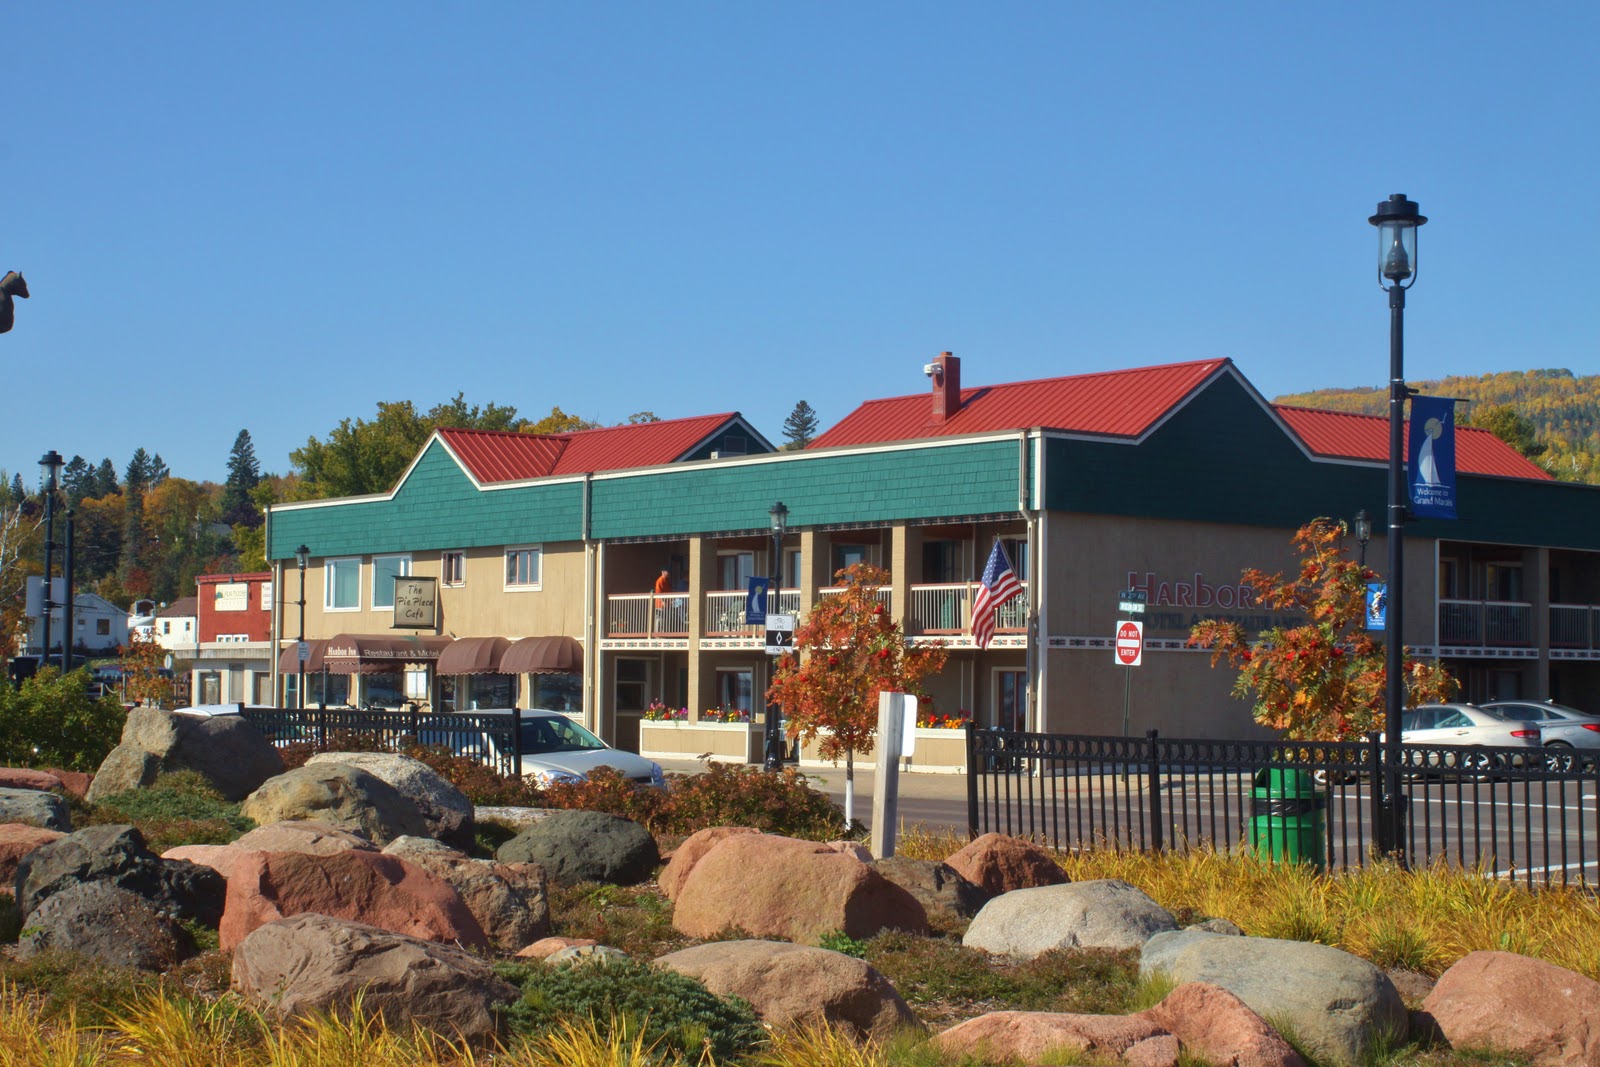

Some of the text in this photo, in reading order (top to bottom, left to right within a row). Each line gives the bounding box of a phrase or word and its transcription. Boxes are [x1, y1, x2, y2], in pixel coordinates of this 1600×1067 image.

[1413, 496, 1453, 506] Grand Marais
[408, 584, 423, 595] The
[396, 596, 434, 607] Pie Place
[1128, 630, 1138, 638] NOT
[364, 648, 440, 658] Restaurant & Motel
